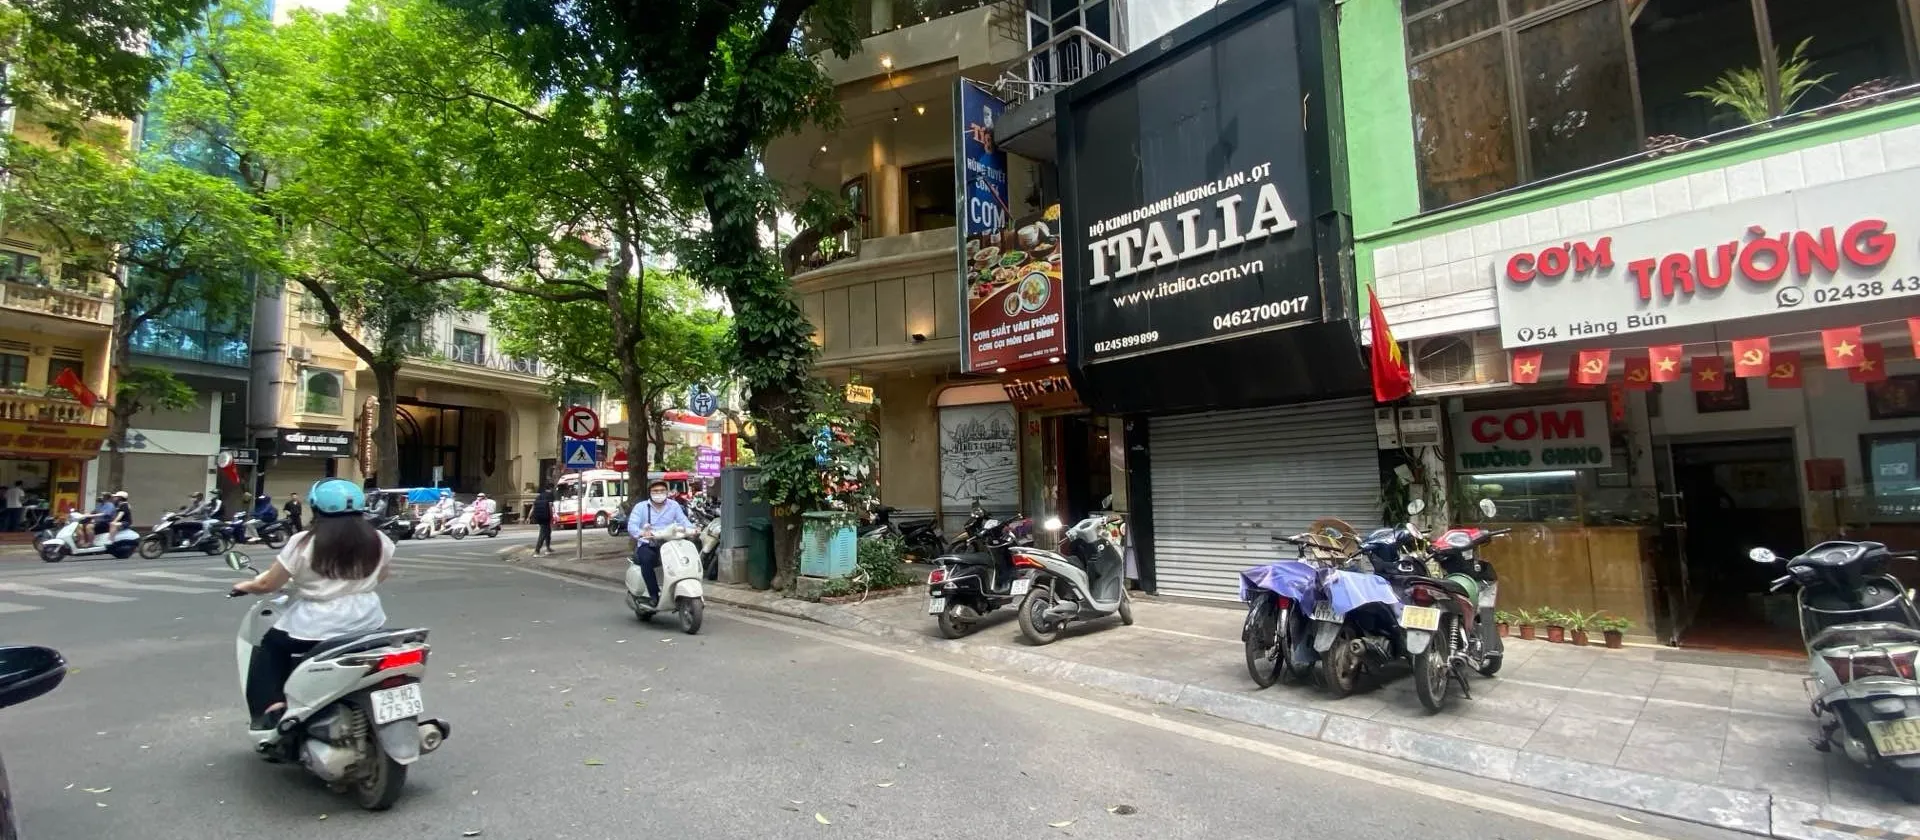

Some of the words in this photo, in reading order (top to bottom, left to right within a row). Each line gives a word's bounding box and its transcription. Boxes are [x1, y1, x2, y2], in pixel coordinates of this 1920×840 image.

[1089, 221, 1105, 237] HỘ
[1106, 212, 1132, 231] KINH
[1133, 197, 1173, 221] DOANH
[1217, 171, 1244, 192] LAN
[1088, 183, 1298, 286] ITALIA
[1506, 236, 1615, 284] CƠM
[1628, 219, 1897, 300] TRƯỜNG
[1113, 260, 1263, 308] www.italia.com.vn
[1814, 281, 1884, 304] 02438
[1891, 276, 1920, 292] 43
[1213, 296, 1309, 330] 0462700017
[1536, 327, 1558, 340] 54
[1569, 321, 1618, 336] Hàng
[1627, 313, 1667, 329] Bún
[1094, 330, 1158, 352] 01245899899
[1471, 409, 1585, 444] CƠM
